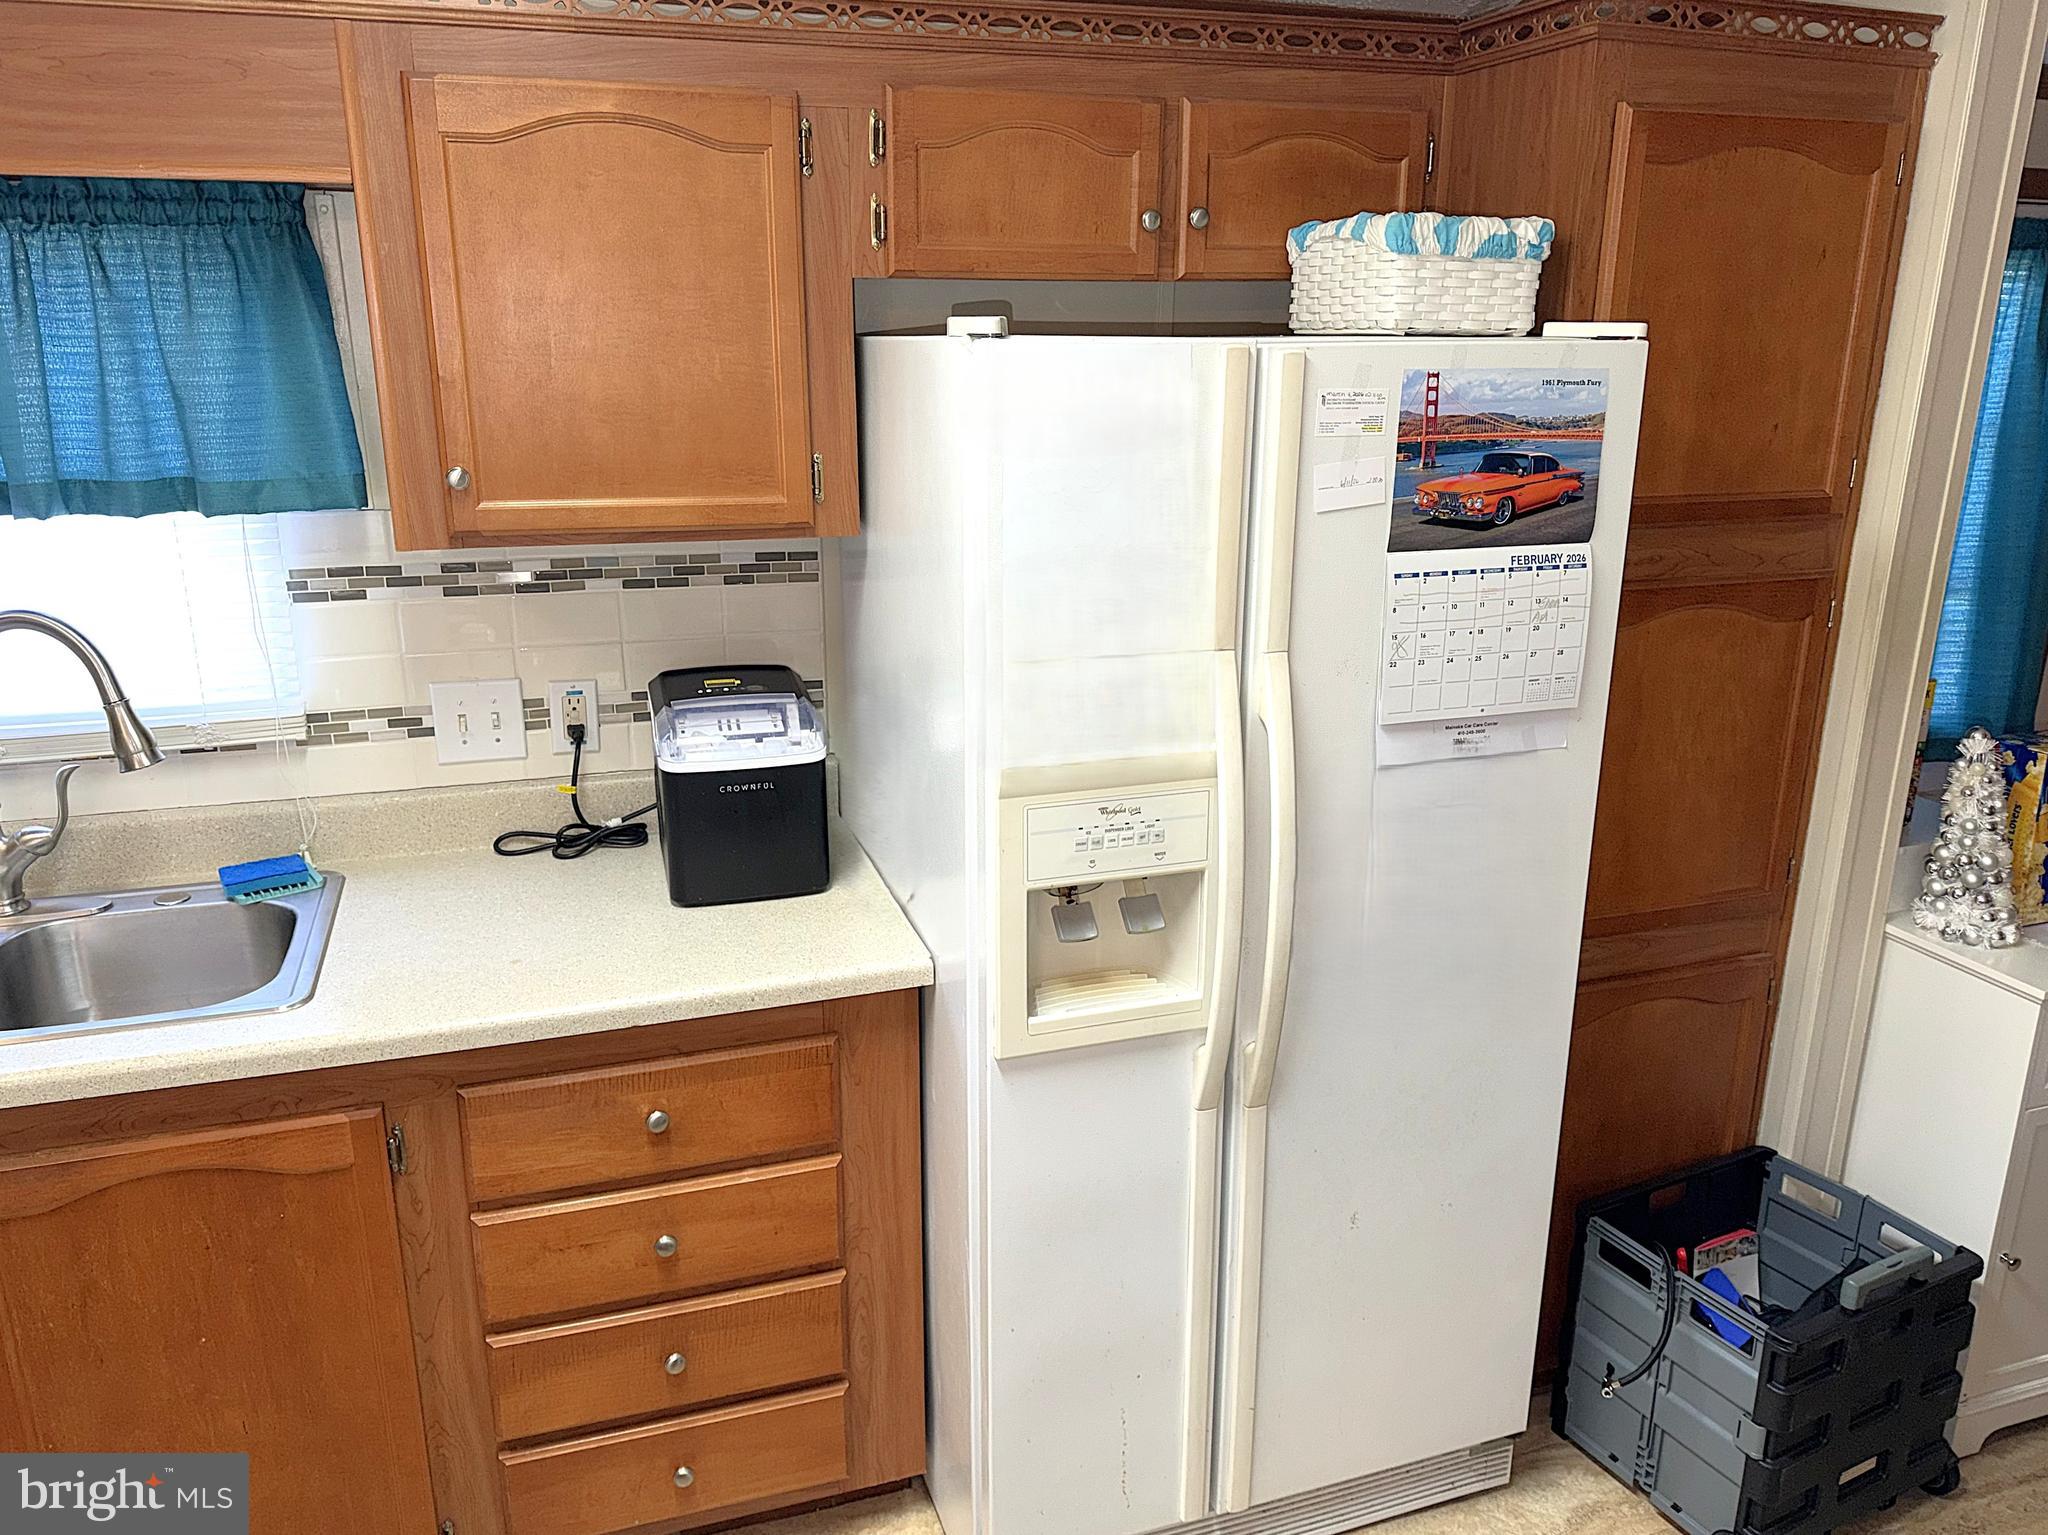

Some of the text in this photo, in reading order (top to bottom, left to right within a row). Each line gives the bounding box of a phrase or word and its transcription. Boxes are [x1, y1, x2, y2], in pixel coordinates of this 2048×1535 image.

[1556, 379, 1586, 387] Plymouth
[1587, 379, 1602, 387] Fury
[1511, 553, 1587, 565] FEBRUARY 2026
[720, 782, 774, 793] CROWNFUL
[1098, 803, 1142, 821] Whirlpool Gold
